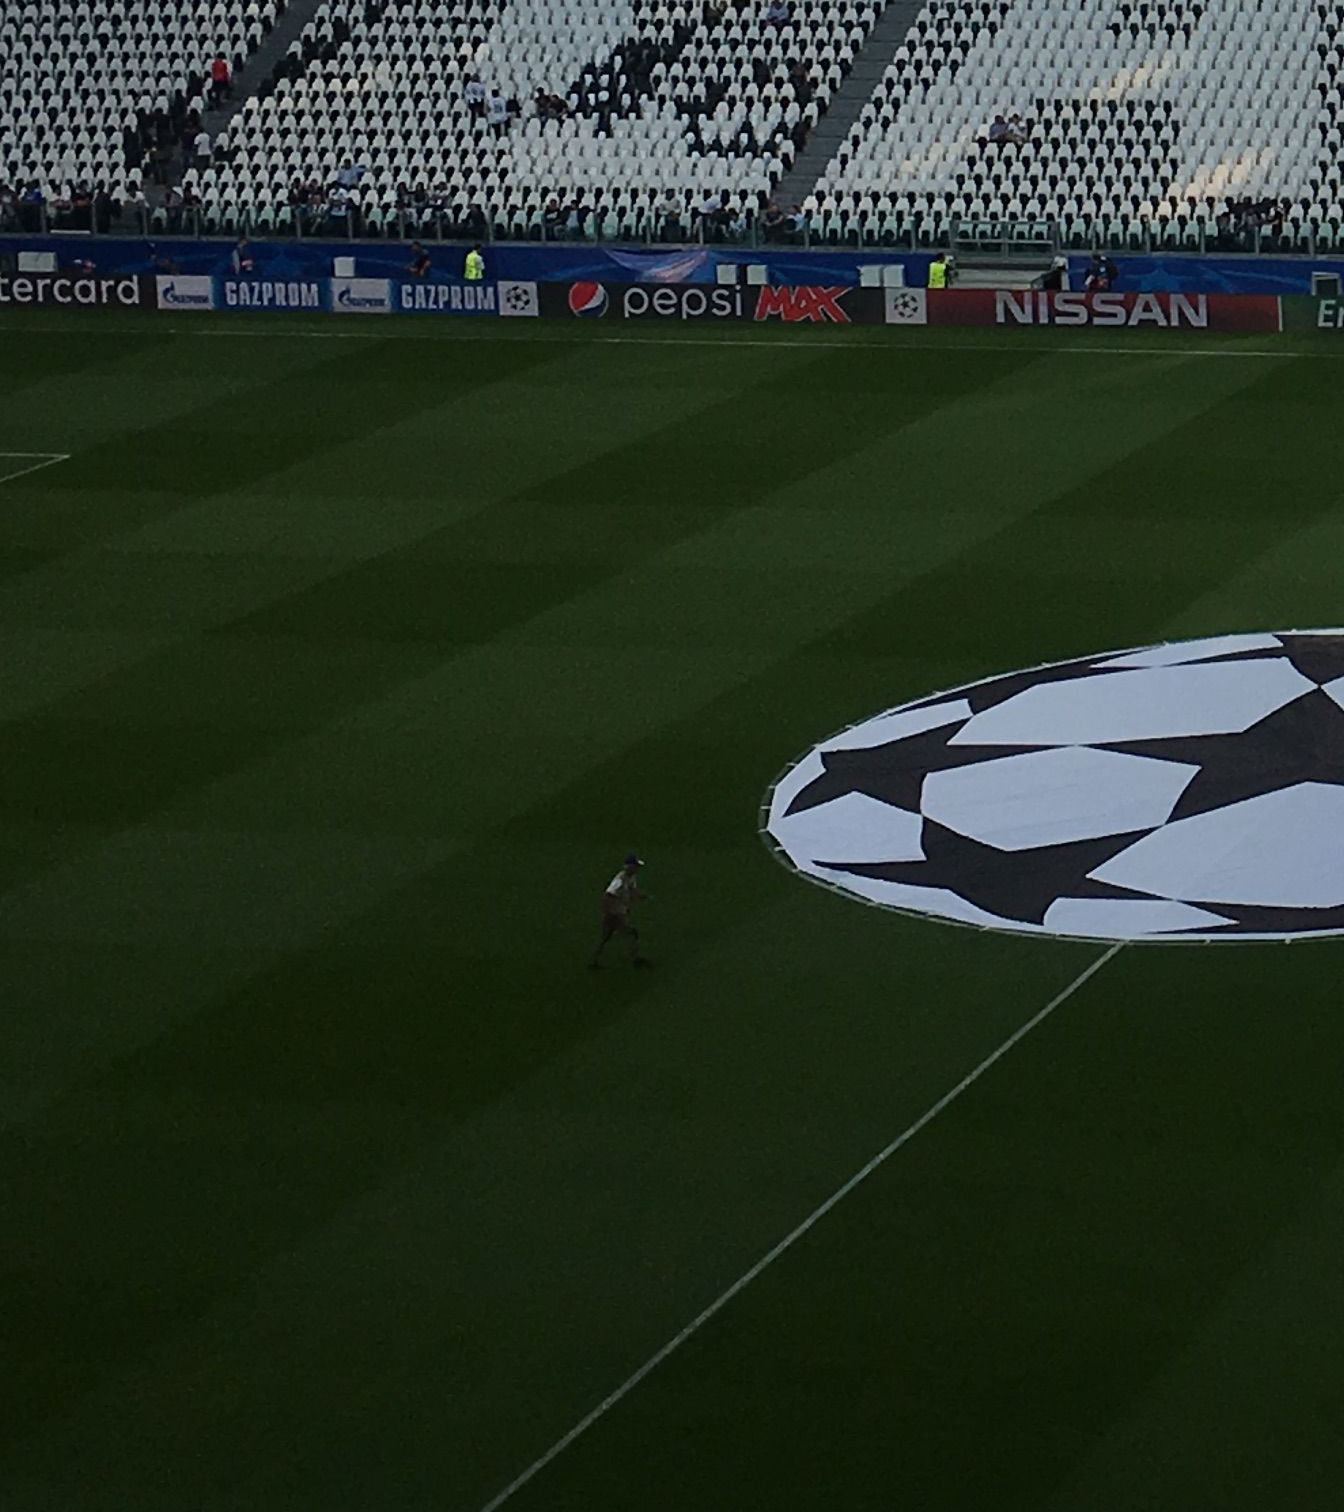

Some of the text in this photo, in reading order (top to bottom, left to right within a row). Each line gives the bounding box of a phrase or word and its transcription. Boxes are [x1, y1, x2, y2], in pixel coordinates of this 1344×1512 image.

[225, 281, 318, 307] GAZPROM
[401, 284, 495, 310] GAZPROM
[624, 285, 852, 322] pepsi MAX
[996, 291, 1208, 327] NISSAN
